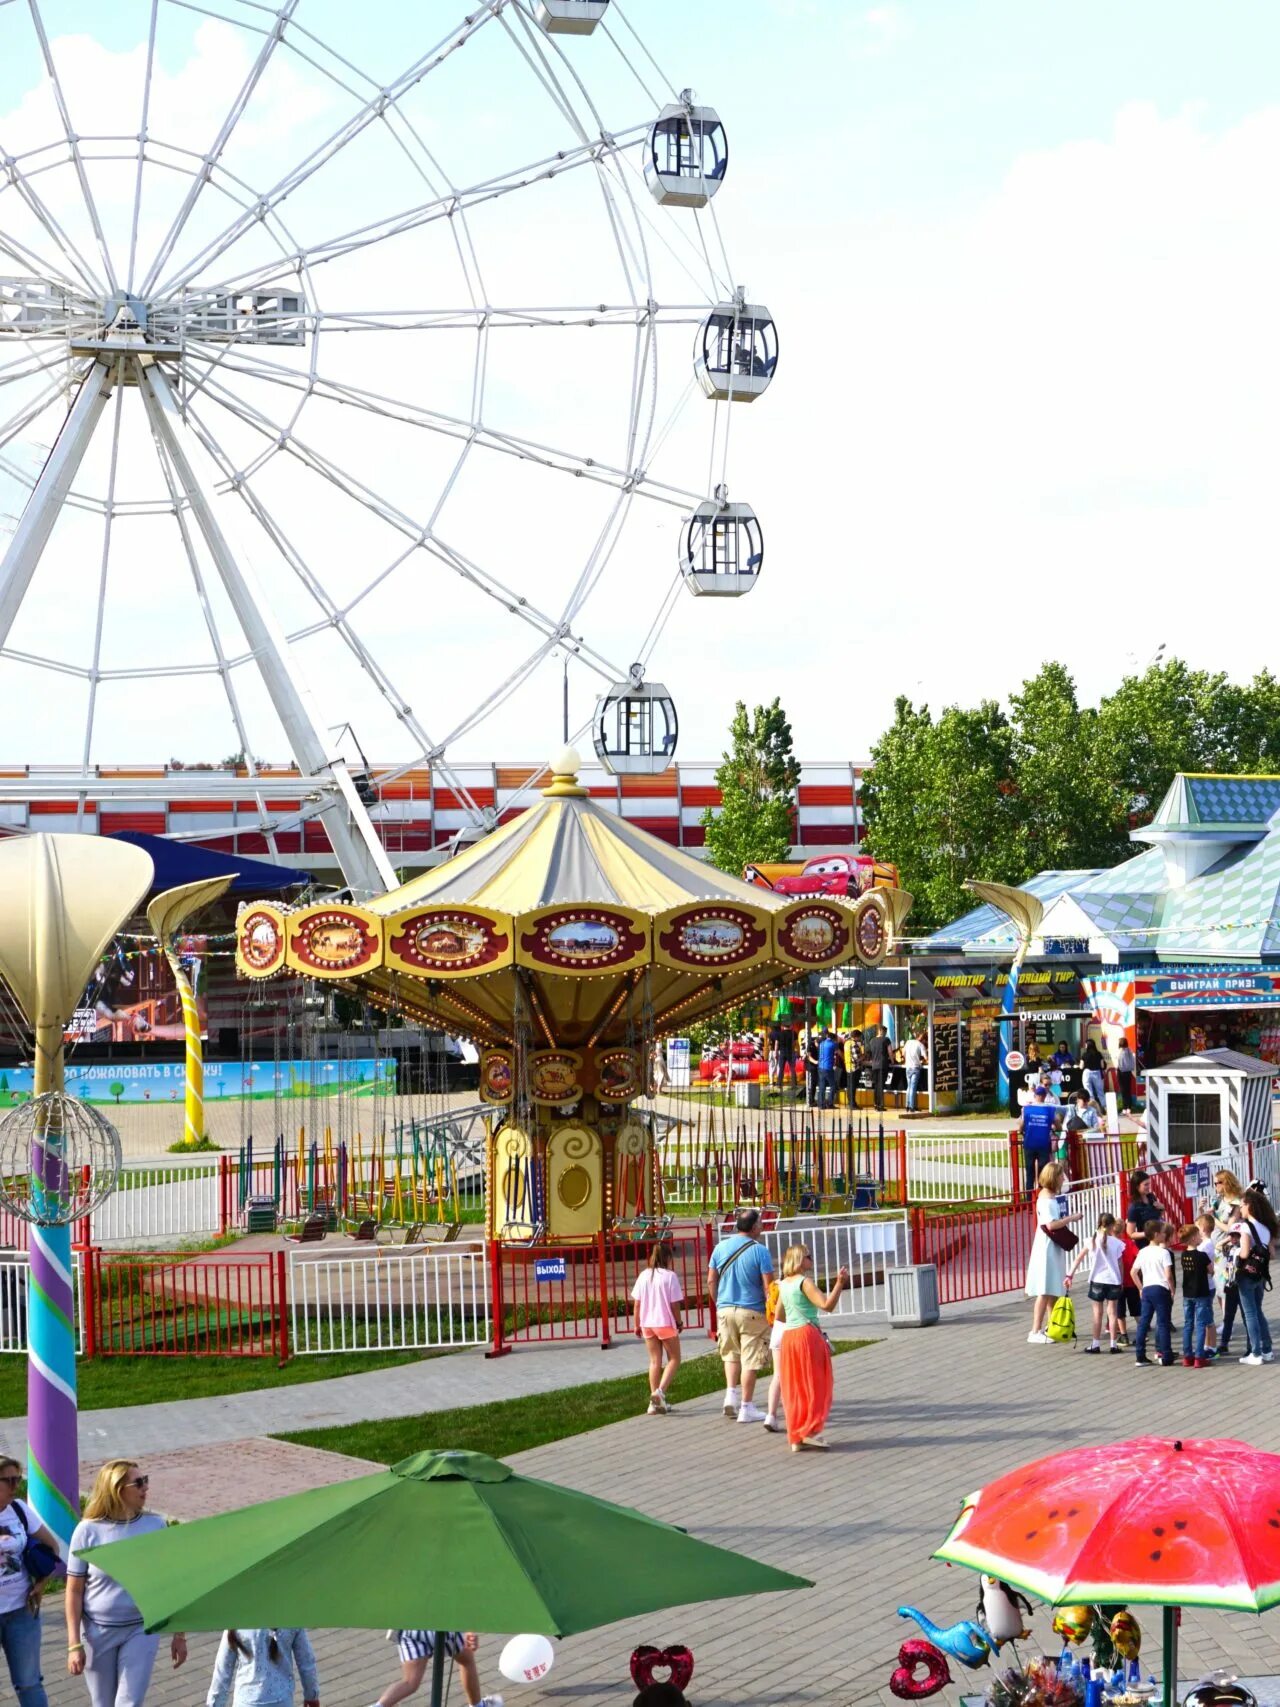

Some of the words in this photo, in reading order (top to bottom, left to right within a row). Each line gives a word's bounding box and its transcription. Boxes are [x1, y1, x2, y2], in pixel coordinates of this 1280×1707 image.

[934, 975, 986, 988] ЛИМОНТИР
[995, 970, 1052, 985] НАОЯЩИЙ
[1170, 979, 1220, 990] ВЫИГРАЙ
[1225, 979, 1256, 989] ПРИЗ!
[80, 1065, 161, 1080] ПОЖАЛОВАТЬ
[163, 1066, 170, 1078] В
[174, 1064, 223, 1078] СККУ!
[536, 1264, 566, 1275] ВЫХОД
